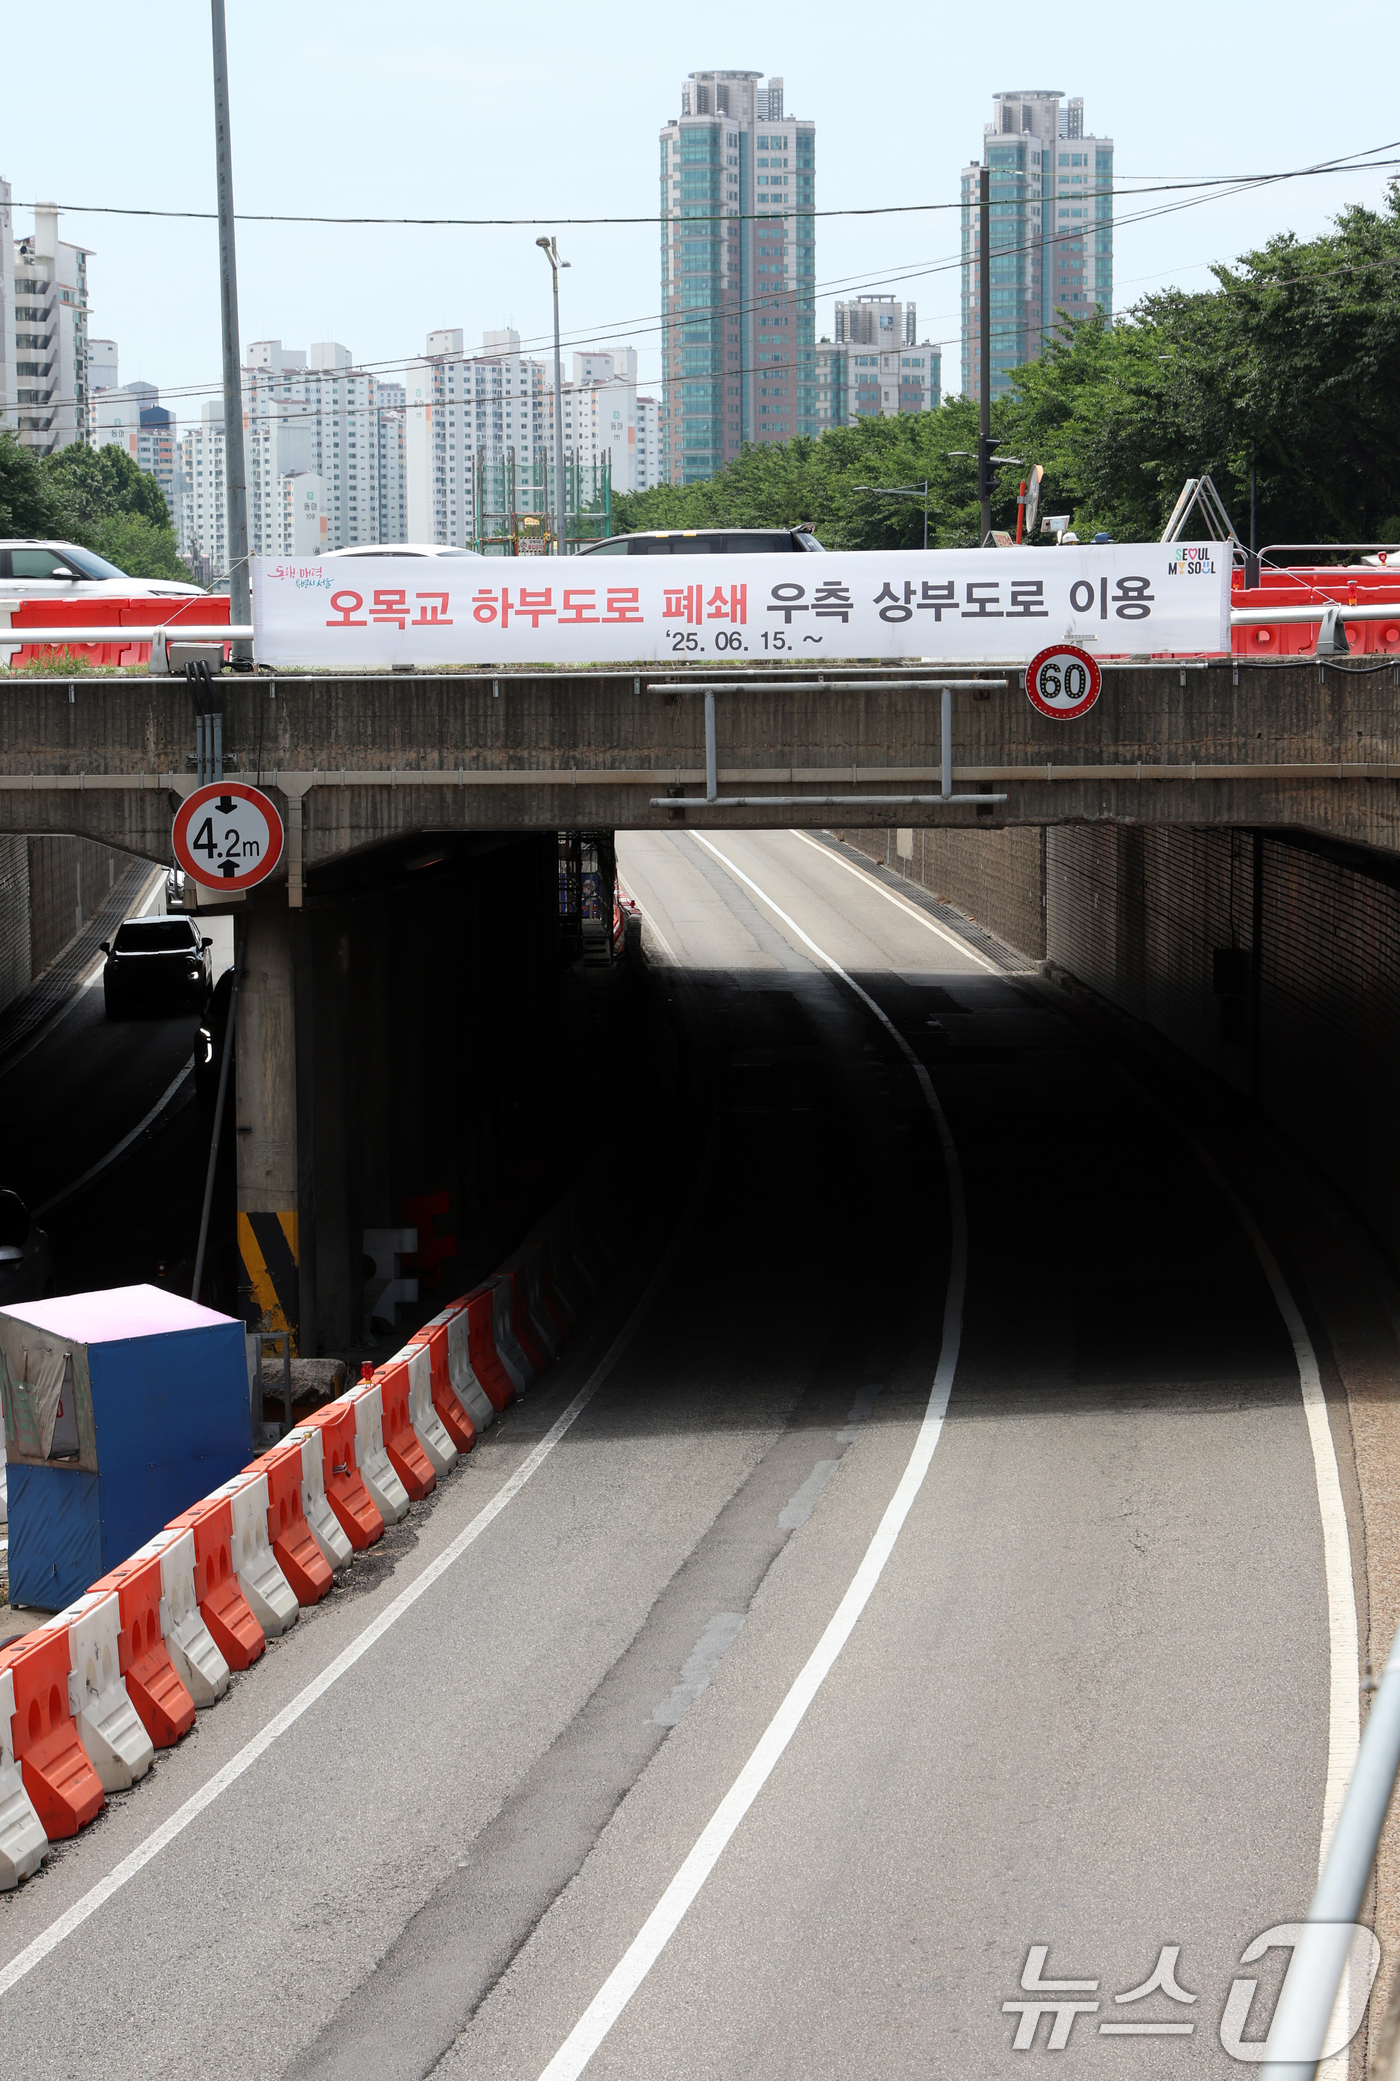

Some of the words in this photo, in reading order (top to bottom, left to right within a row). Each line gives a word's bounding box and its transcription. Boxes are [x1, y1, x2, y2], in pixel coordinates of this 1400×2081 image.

[295, 578, 316, 589] 특별시
[316, 577, 335, 589] 서울
[326, 589, 454, 630] 오목교
[472, 587, 644, 629] 하부도로
[662, 583, 747, 626] 폐쇄
[766, 581, 854, 624] 우측
[873, 580, 1049, 623] 상부도로
[1069, 576, 1155, 620] 이용
[715, 631, 749, 652] 06.
[760, 631, 793, 651] 15.
[1040, 663, 1086, 699] 60
[193, 817, 260, 859] 4.2m
